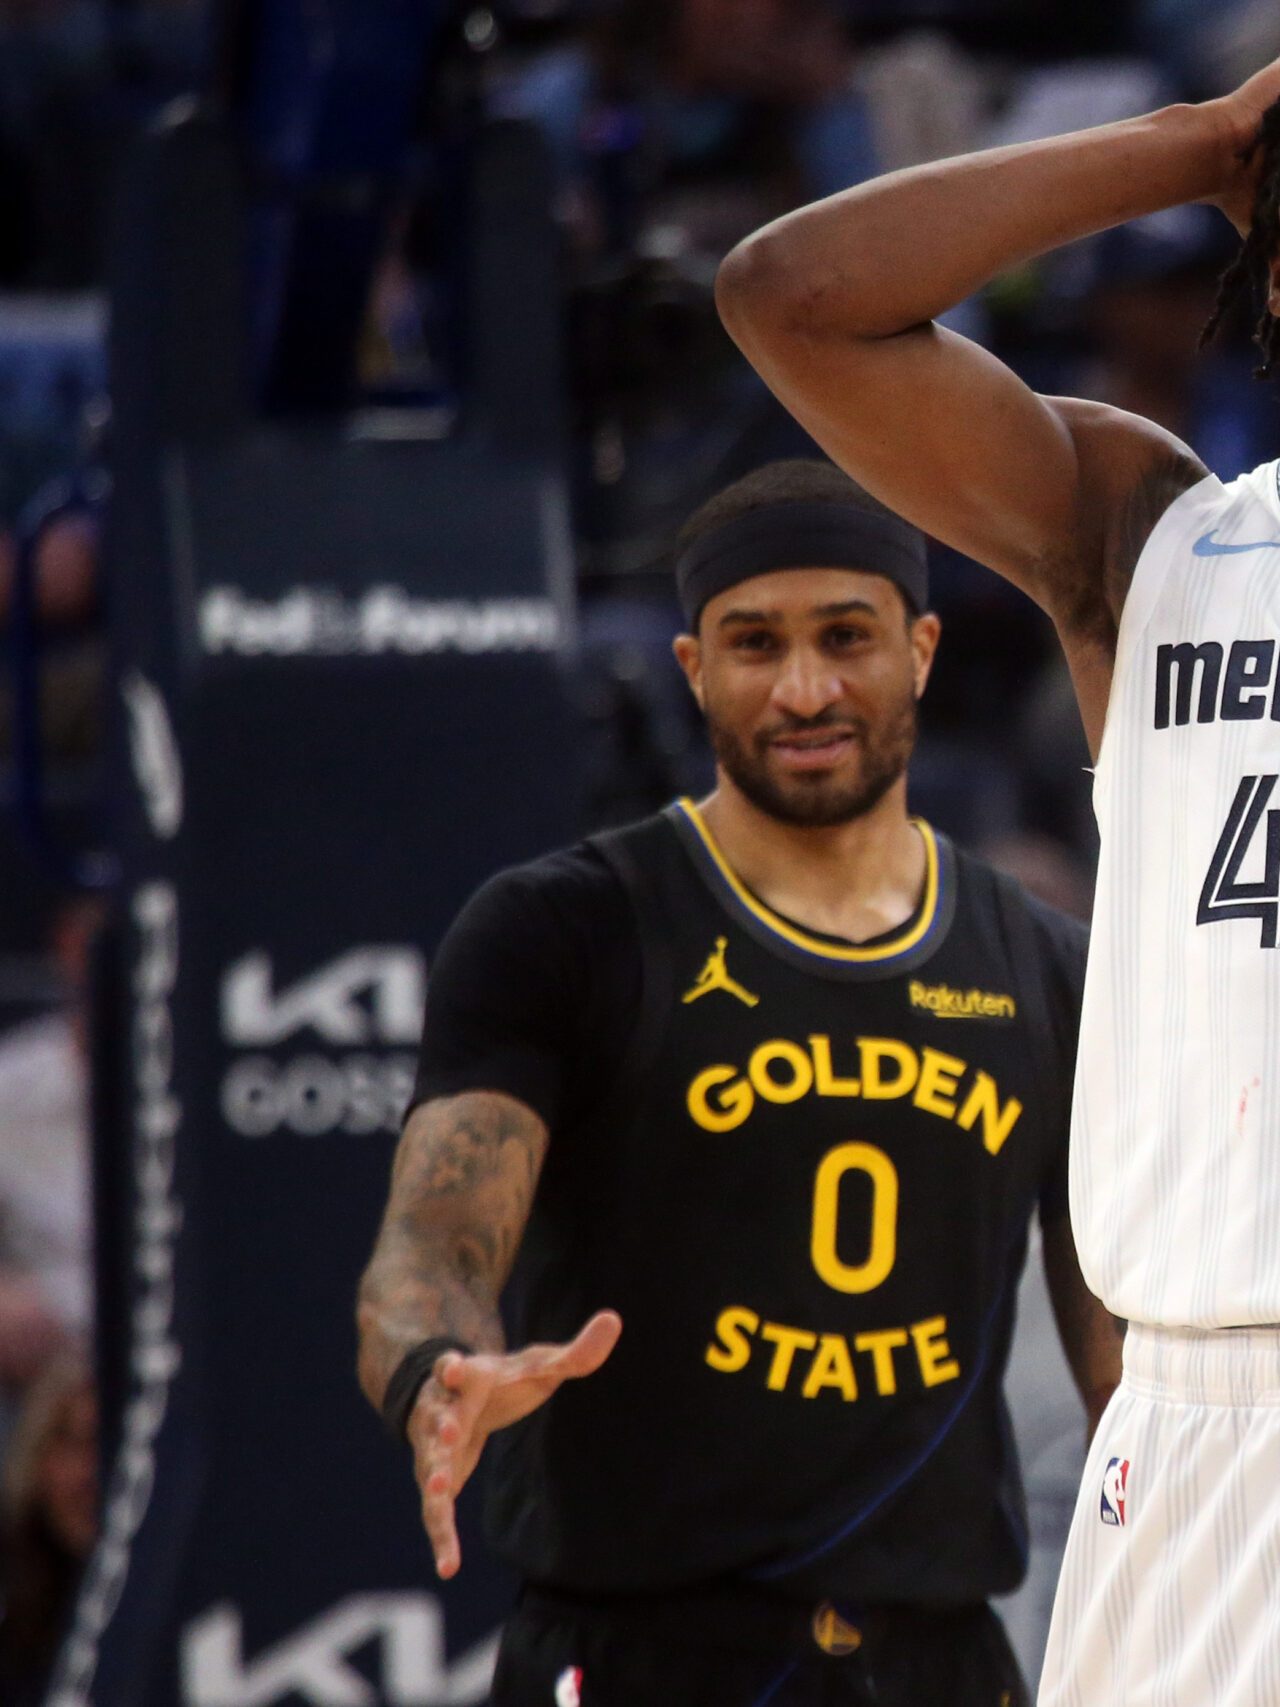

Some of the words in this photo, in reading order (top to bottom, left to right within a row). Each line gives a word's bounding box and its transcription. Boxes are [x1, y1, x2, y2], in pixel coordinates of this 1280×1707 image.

[221, 947, 425, 1045] KI
[908, 980, 1016, 1019] Rakuten
[687, 1033, 1024, 1157] GOLDEN
[811, 1140, 898, 1295] 0
[705, 1305, 961, 1402] STATE
